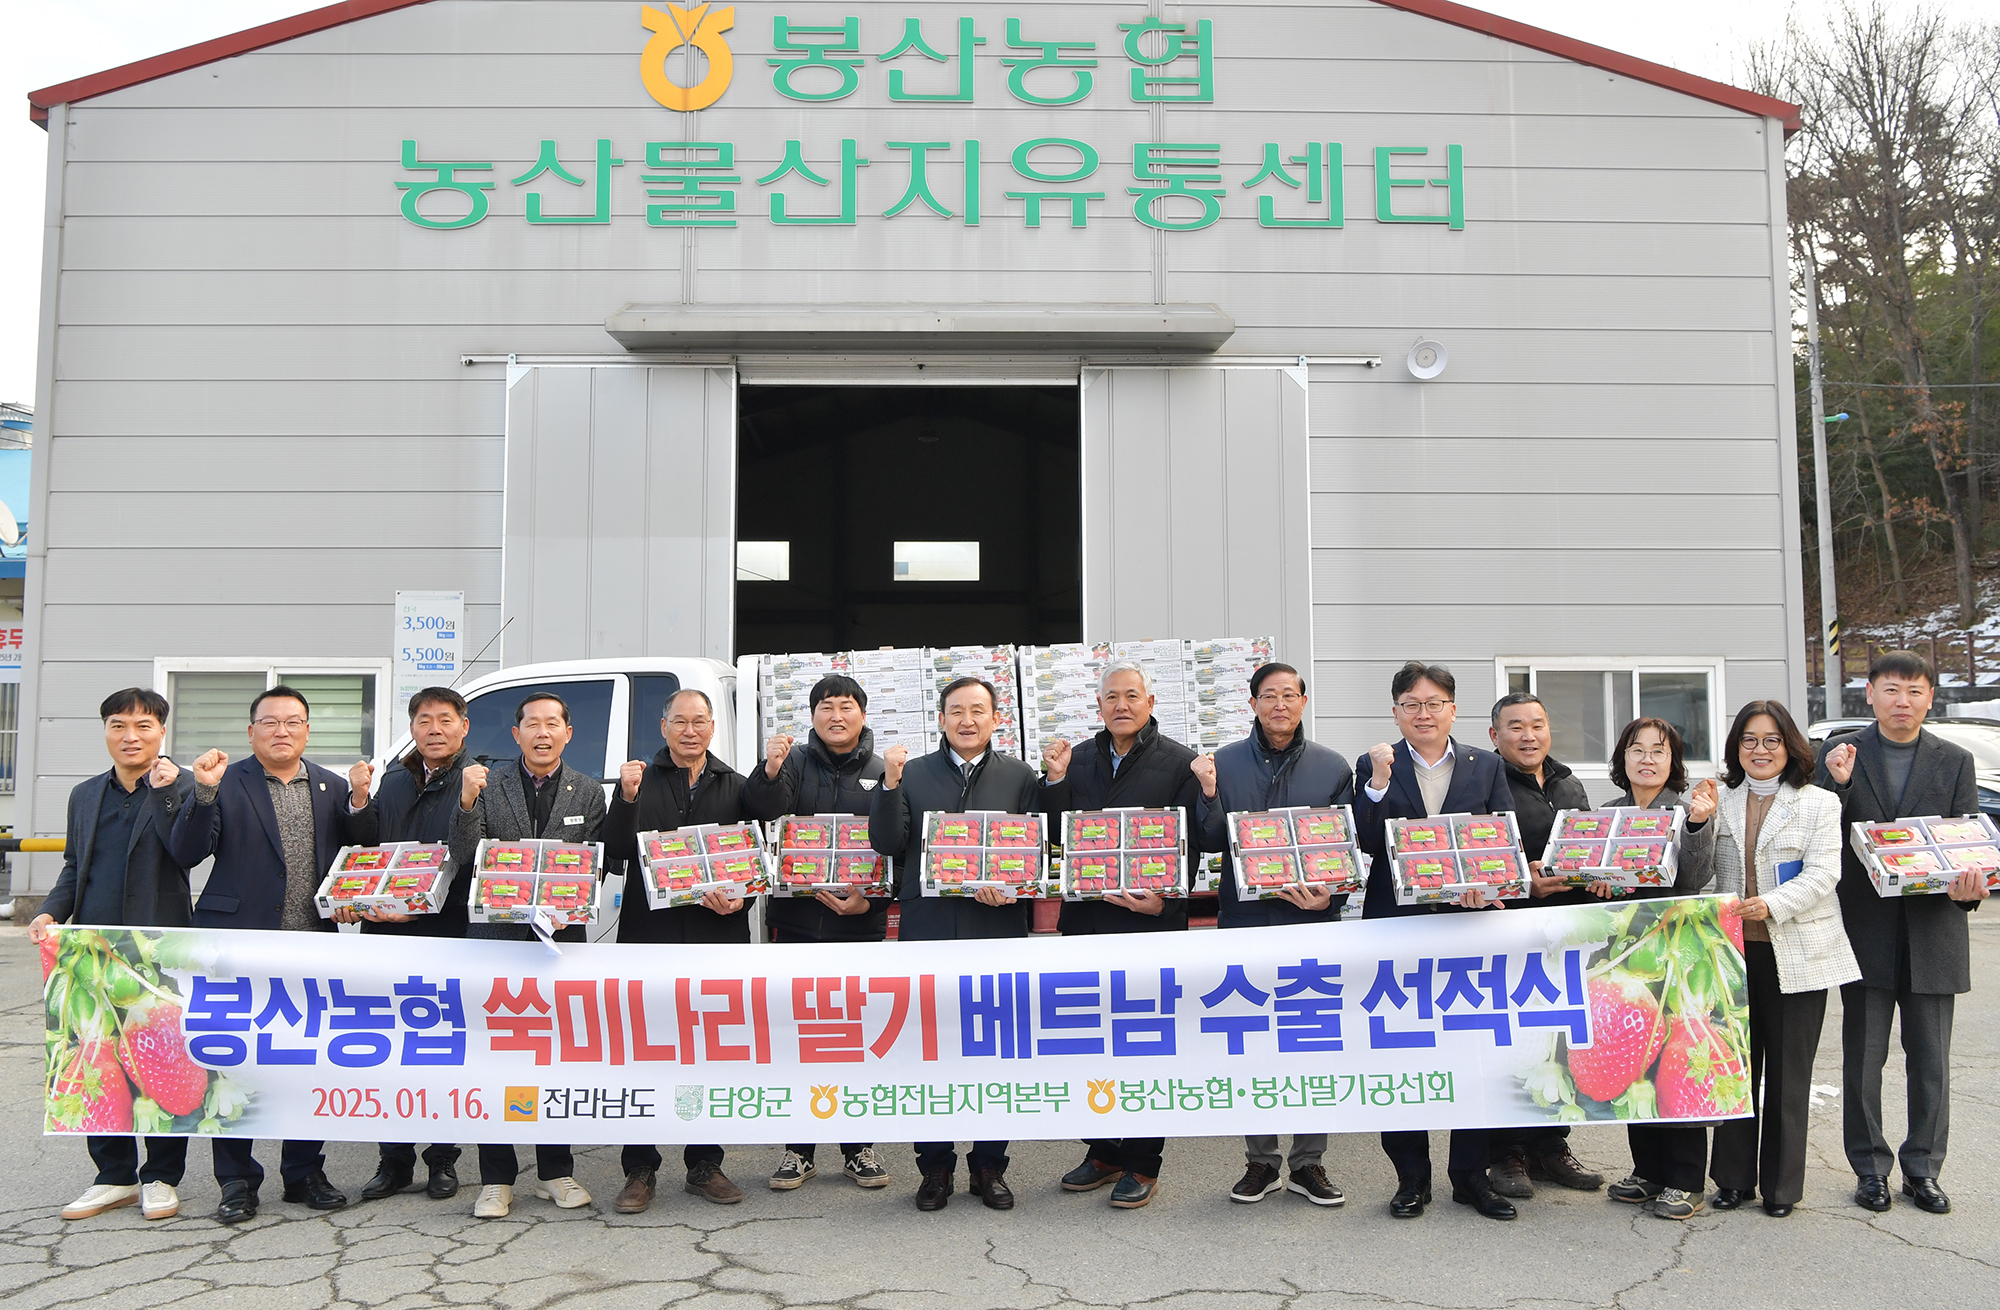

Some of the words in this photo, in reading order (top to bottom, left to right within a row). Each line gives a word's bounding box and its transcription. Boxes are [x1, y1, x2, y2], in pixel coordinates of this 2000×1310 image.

[766, 15, 1215, 105] 봉산농협
[393, 137, 1465, 231] 농산물산지유통센터
[402, 616, 455, 632] 3,500원
[402, 647, 455, 664] 5,500원
[185, 974, 467, 1068] 봉산농협
[482, 976, 771, 1066] 쑥미나리
[791, 974, 939, 1064] 딸기
[959, 966, 1183, 1060] 베트남
[1199, 957, 1344, 1056] 수출
[1359, 949, 1590, 1051] 선적식
[311, 1087, 389, 1120] 2025.
[395, 1087, 439, 1120] 01.
[447, 1087, 490, 1120] 16.
[543, 1087, 656, 1119] 전라남도
[709, 1086, 793, 1119] 담양군
[842, 1080, 1071, 1118] 농협전남지역본부
